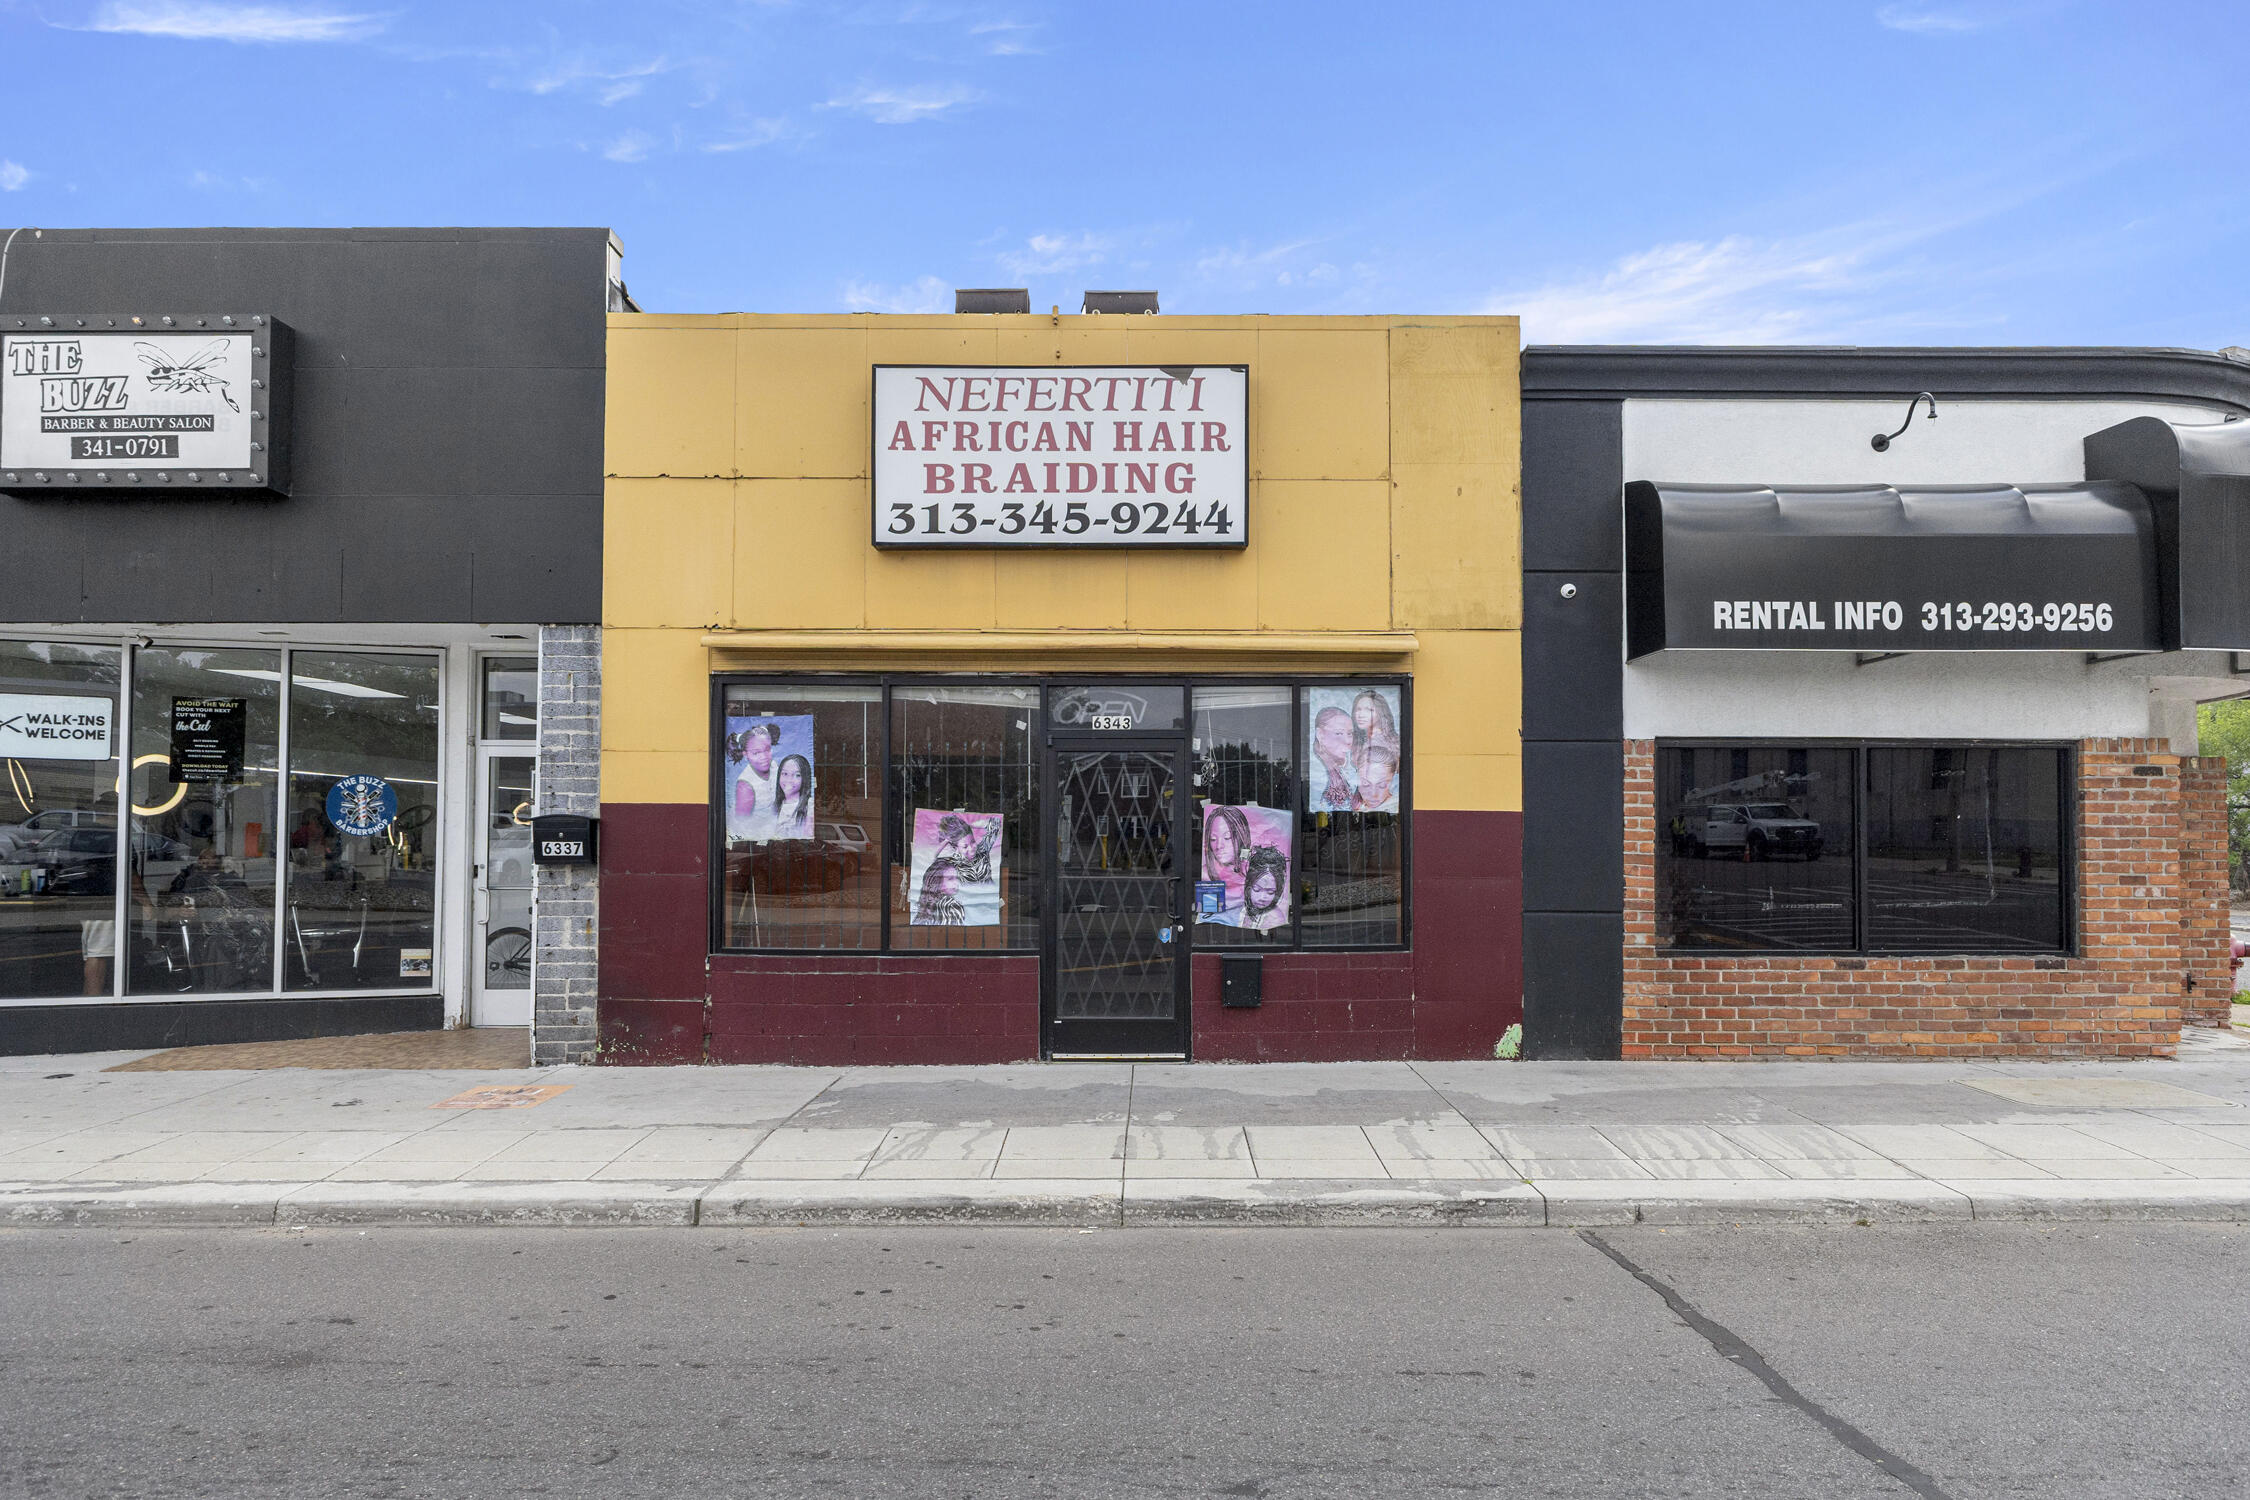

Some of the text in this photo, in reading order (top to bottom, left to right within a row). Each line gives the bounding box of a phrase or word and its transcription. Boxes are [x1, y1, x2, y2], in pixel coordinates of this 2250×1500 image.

[8, 340, 83, 376] THE
[41, 375, 129, 412] BUZZ
[914, 376, 1207, 412] NEFERTITI
[44, 418, 94, 430] BARBER
[99, 418, 109, 429] &
[113, 417, 166, 429] BEAUTY
[169, 417, 212, 429] SALON
[888, 420, 1232, 452] AFRICAN HAIR
[82, 438, 168, 456] 341-0791
[923, 462, 1197, 494] BRAIDING
[887, 499, 1234, 535] 313-345-9244
[1713, 600, 2113, 632] RENTAL INFO 313-293-9256
[26, 713, 105, 726] WALK-INS
[1093, 717, 1131, 729] 6343
[25, 727, 105, 740] WELCOME
[337, 776, 386, 790] THE BUZZ
[336, 819, 388, 836] BARBERSHOP
[544, 842, 581, 855] 6337
